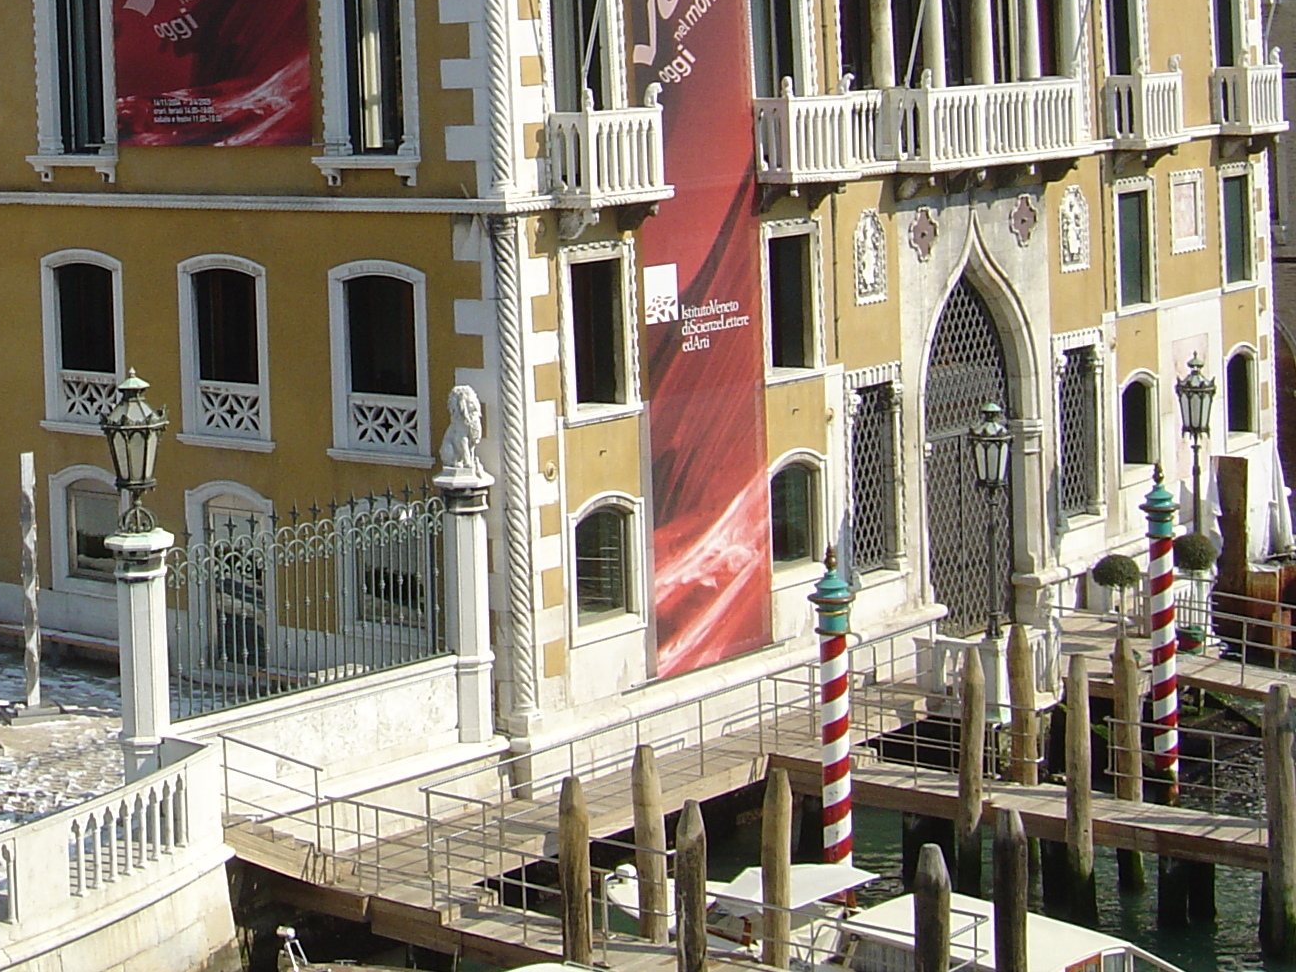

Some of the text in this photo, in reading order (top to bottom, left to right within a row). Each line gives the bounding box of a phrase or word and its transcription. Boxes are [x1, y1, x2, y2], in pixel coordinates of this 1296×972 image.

[153, 7, 198, 41] oggi
[673, 19, 691, 42] nel
[658, 44, 696, 83] oggi
